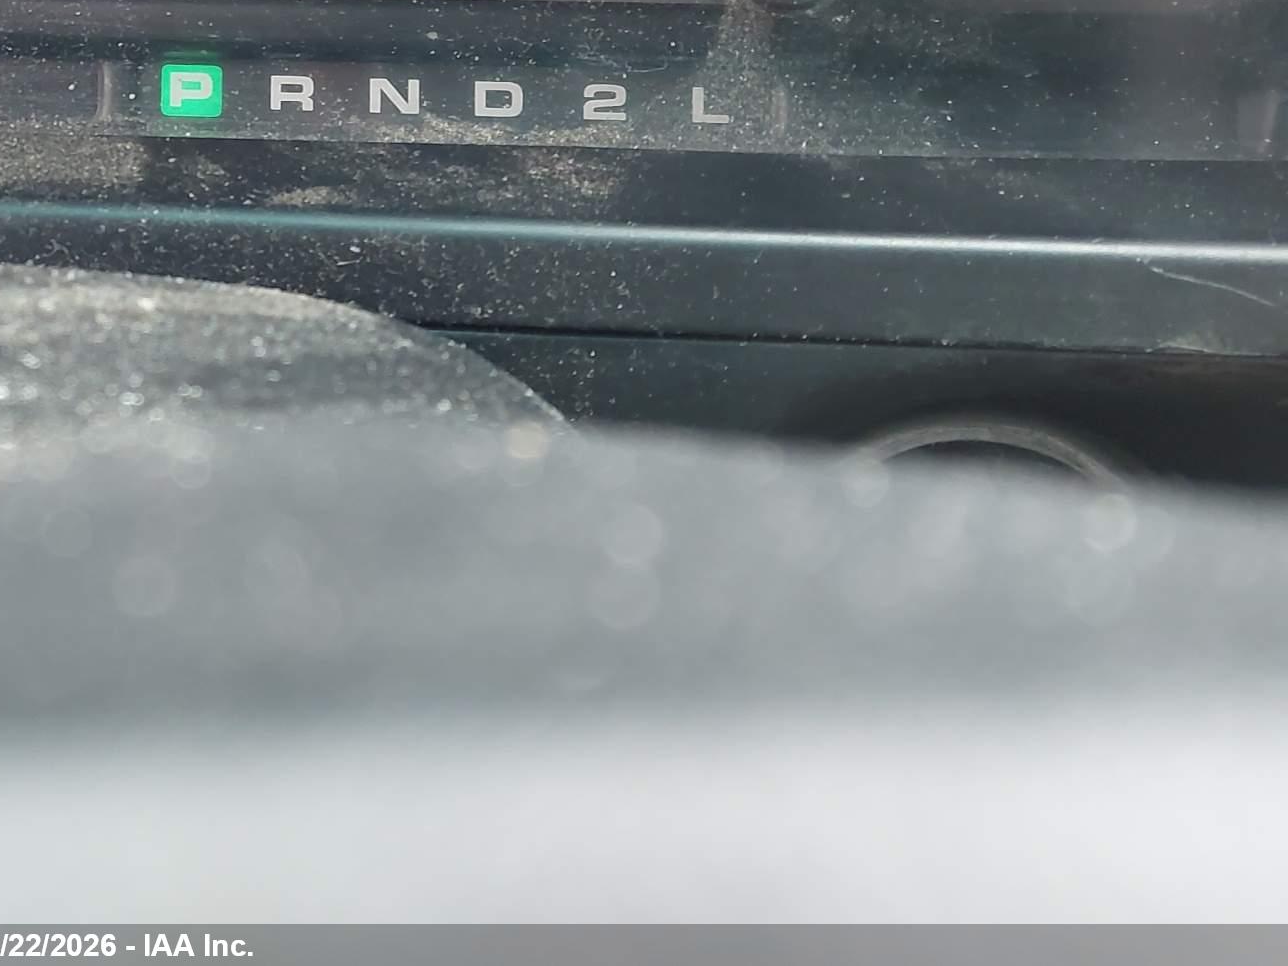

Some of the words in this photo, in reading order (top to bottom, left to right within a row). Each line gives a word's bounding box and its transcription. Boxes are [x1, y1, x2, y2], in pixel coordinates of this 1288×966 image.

[169, 72, 212, 107] P
[270, 75, 313, 111] R
[369, 78, 420, 114] N
[474, 81, 523, 117] D
[583, 84, 626, 120] 2
[692, 87, 729, 123] L
